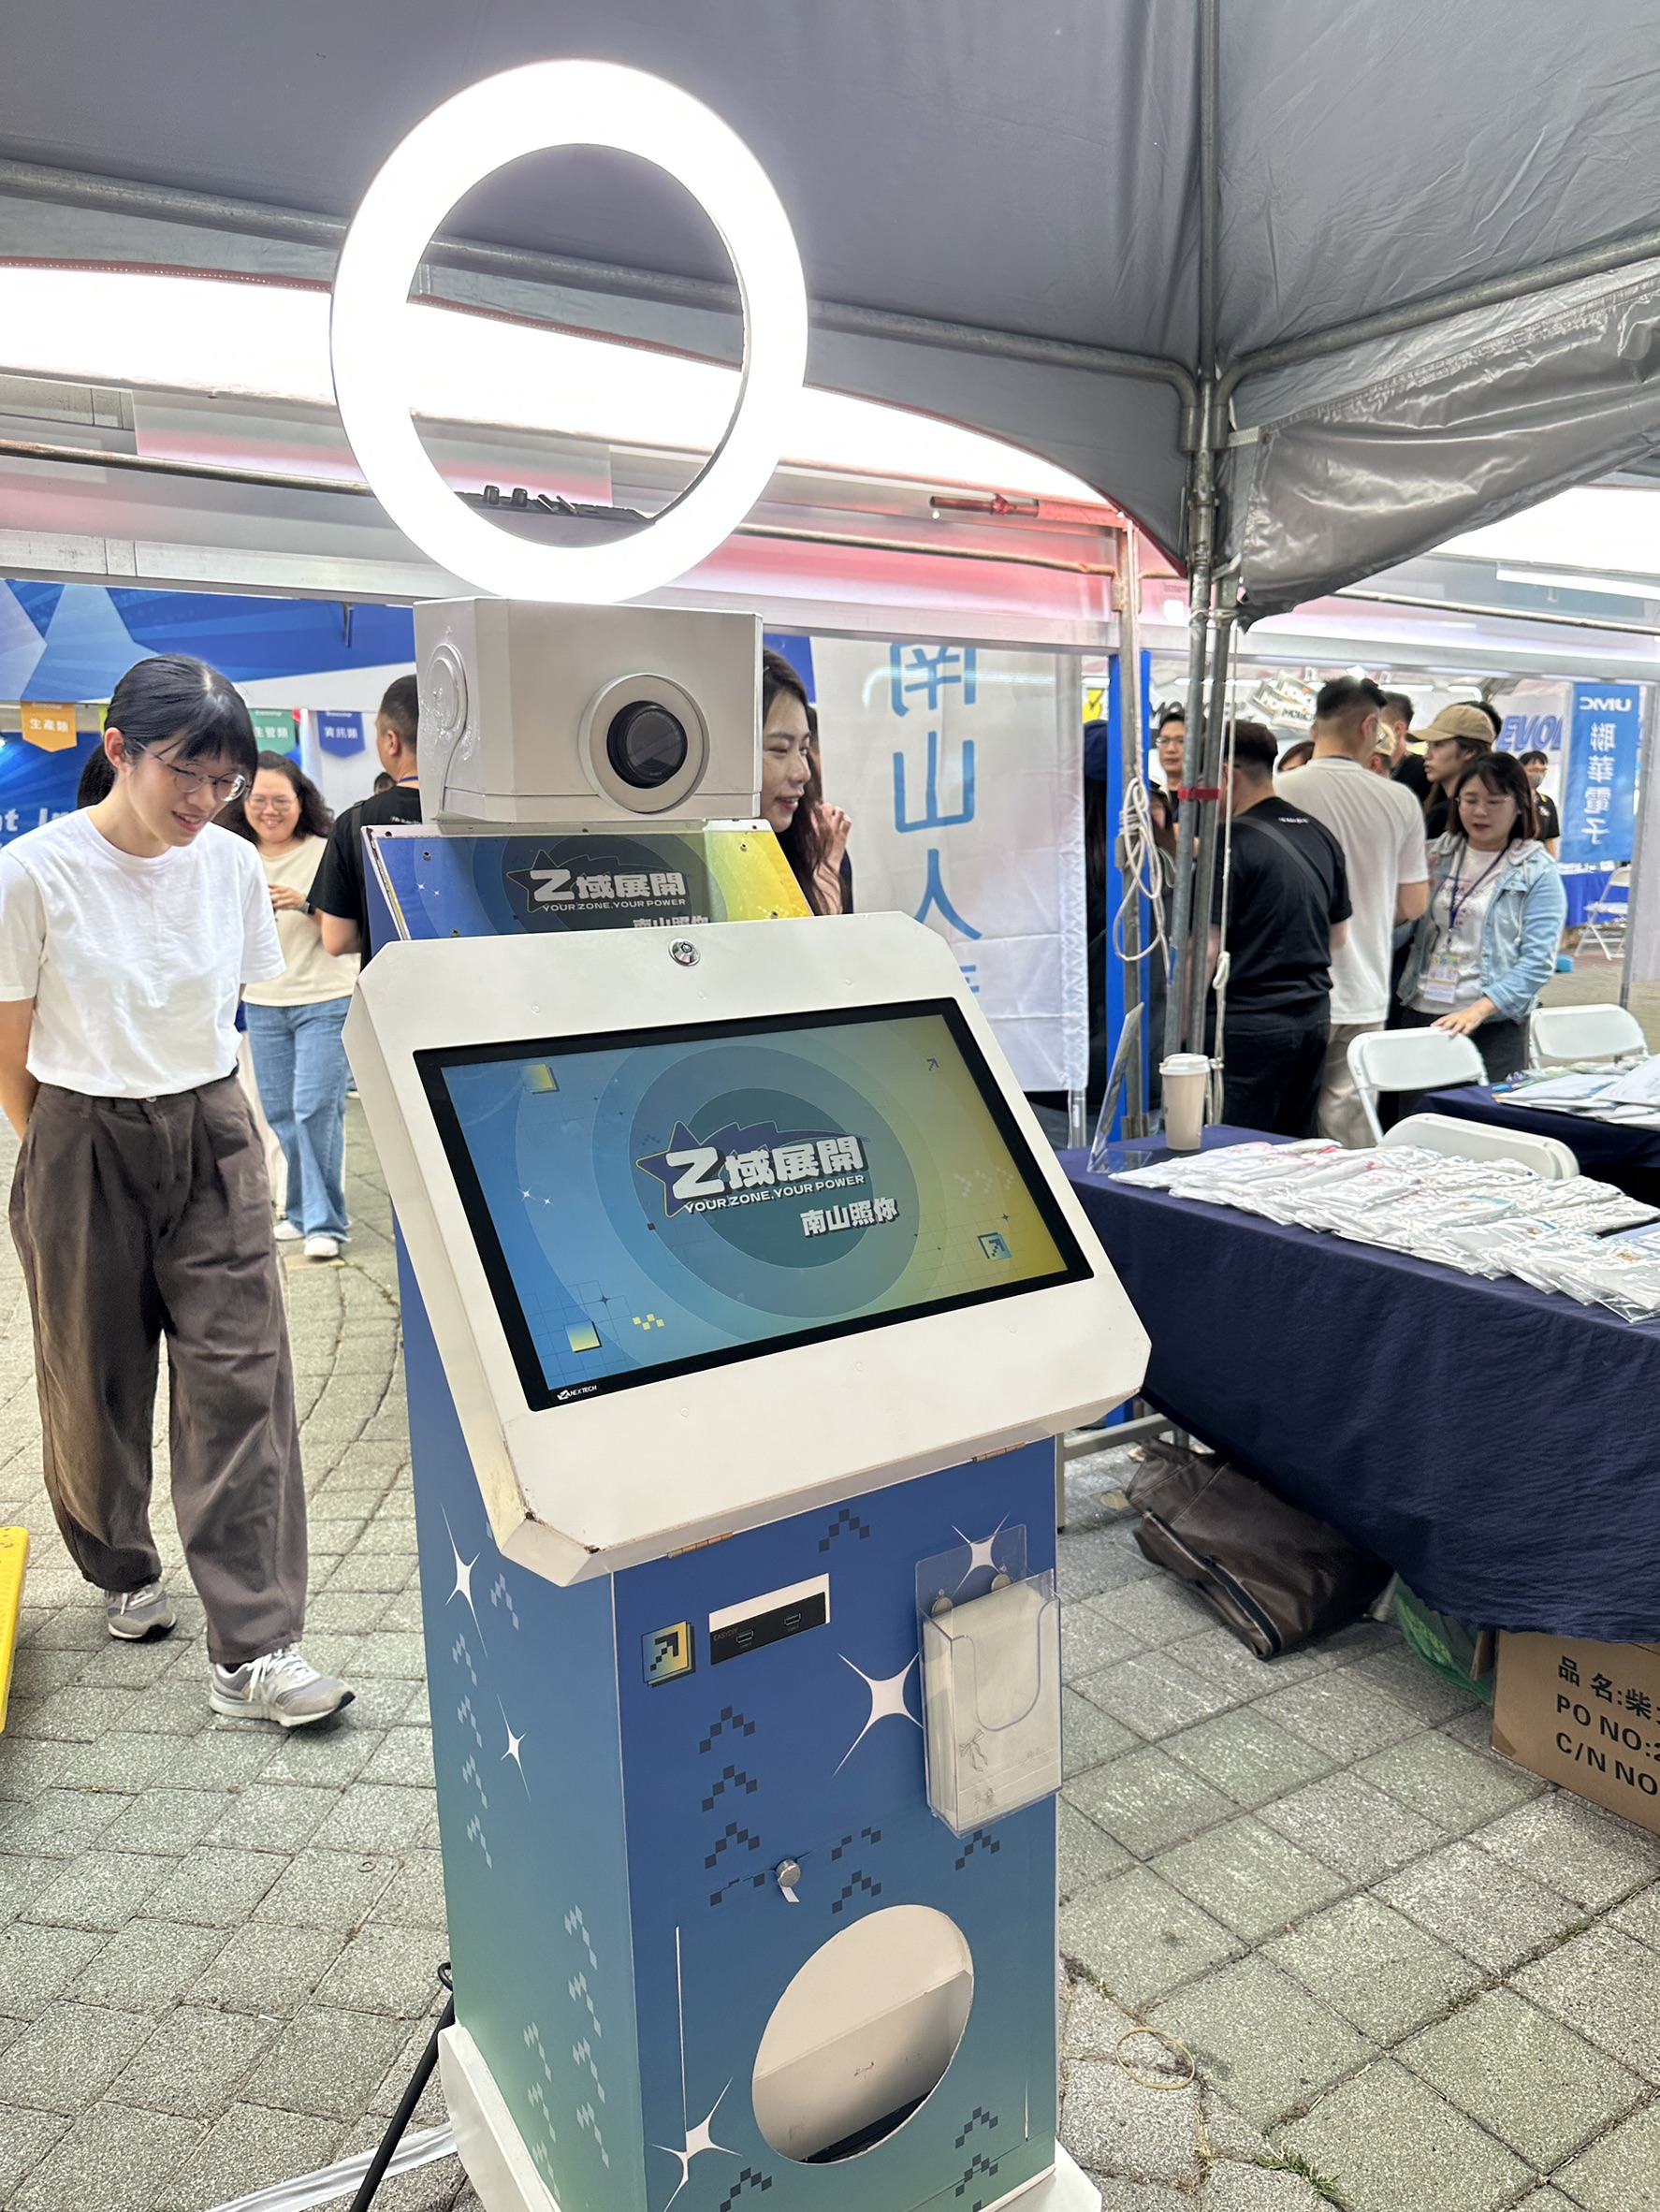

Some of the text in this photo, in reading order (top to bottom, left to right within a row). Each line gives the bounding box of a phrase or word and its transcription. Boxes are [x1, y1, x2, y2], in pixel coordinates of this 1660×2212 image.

[530, 869, 687, 901] Z域展開
[542, 903, 575, 912] YOUR
[646, 898, 686, 907] POWER
[665, 1136, 865, 1200] Z域展開
[684, 1198, 727, 1214] YOUR
[815, 1174, 865, 1191] POWER
[800, 1196, 899, 1236] 南山照你
[1557, 1694, 1591, 1726] PO
[1556, 1732, 1658, 1796] C/N NO
